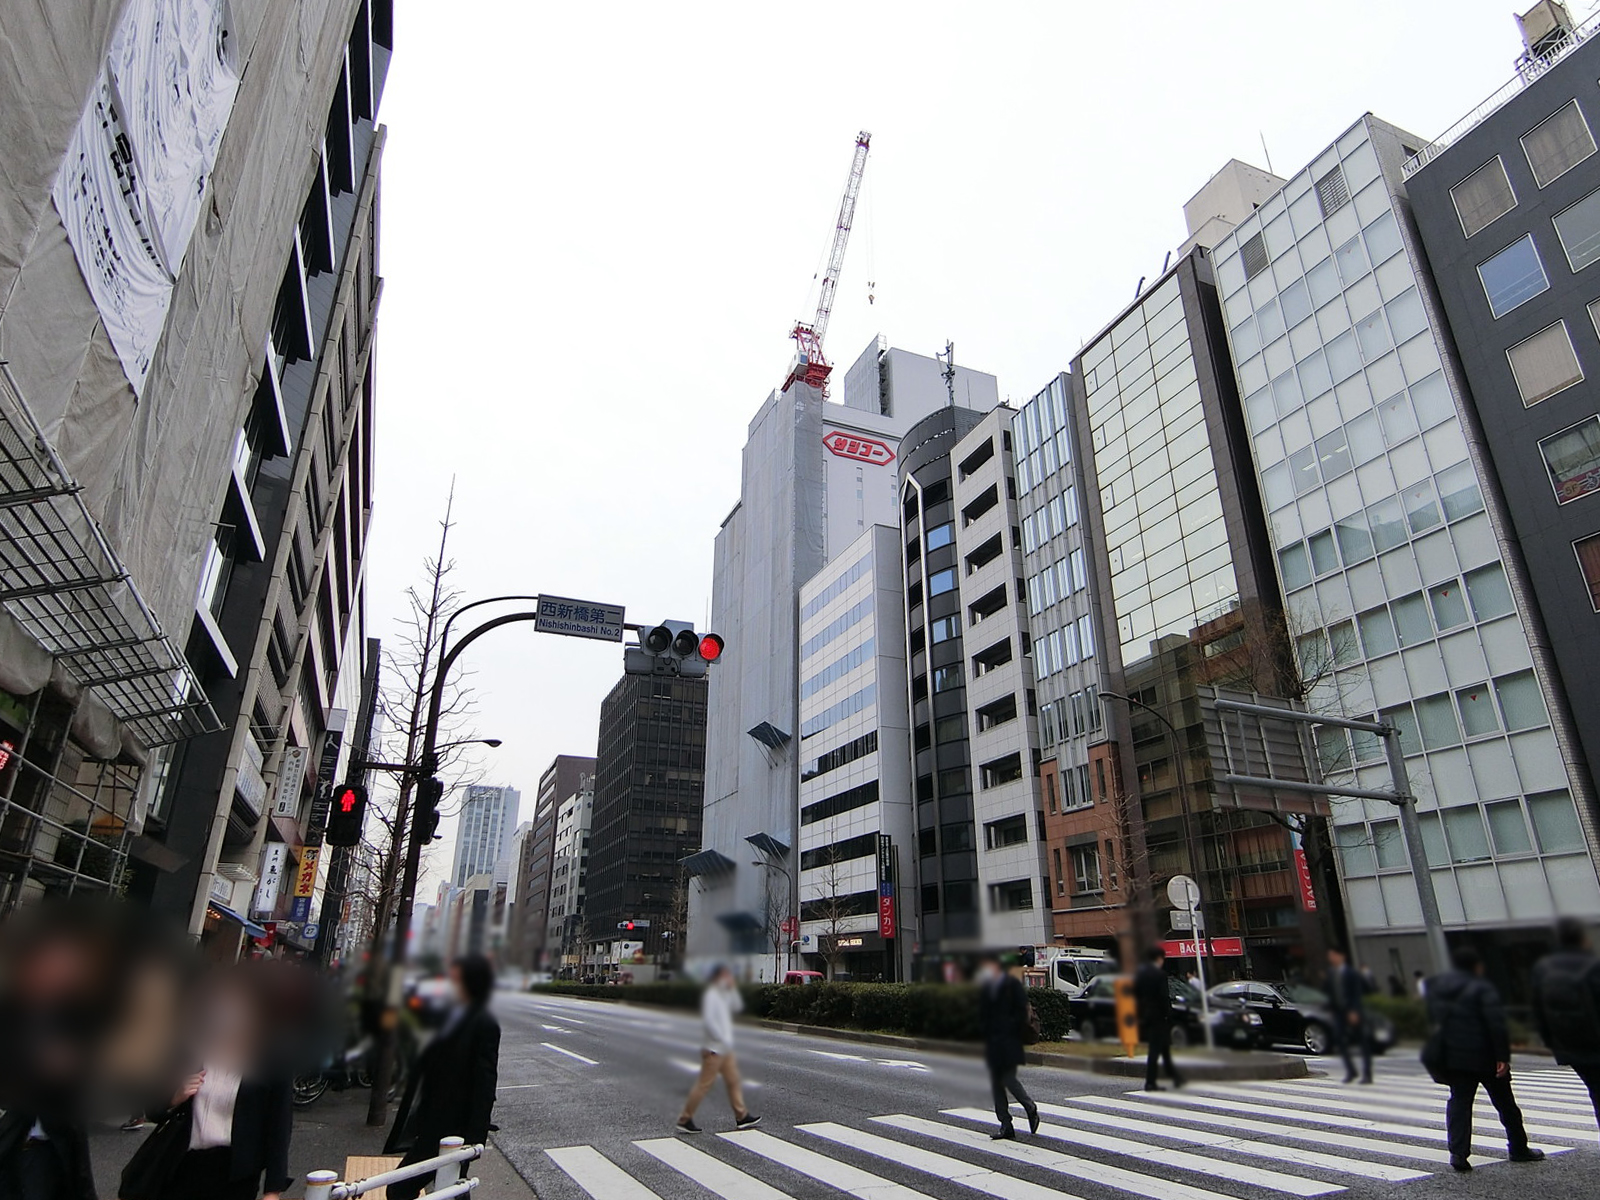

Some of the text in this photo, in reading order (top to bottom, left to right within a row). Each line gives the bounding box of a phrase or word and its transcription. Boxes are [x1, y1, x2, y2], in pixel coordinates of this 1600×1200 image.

[834, 437, 884, 457] サンコー
[541, 601, 621, 626] 西新橋第二
[539, 618, 620, 636] Nishishinbashi No. 2
[299, 861, 314, 894] メガネ
[883, 898, 892, 935] タンカン
[306, 927, 315, 935] 27
